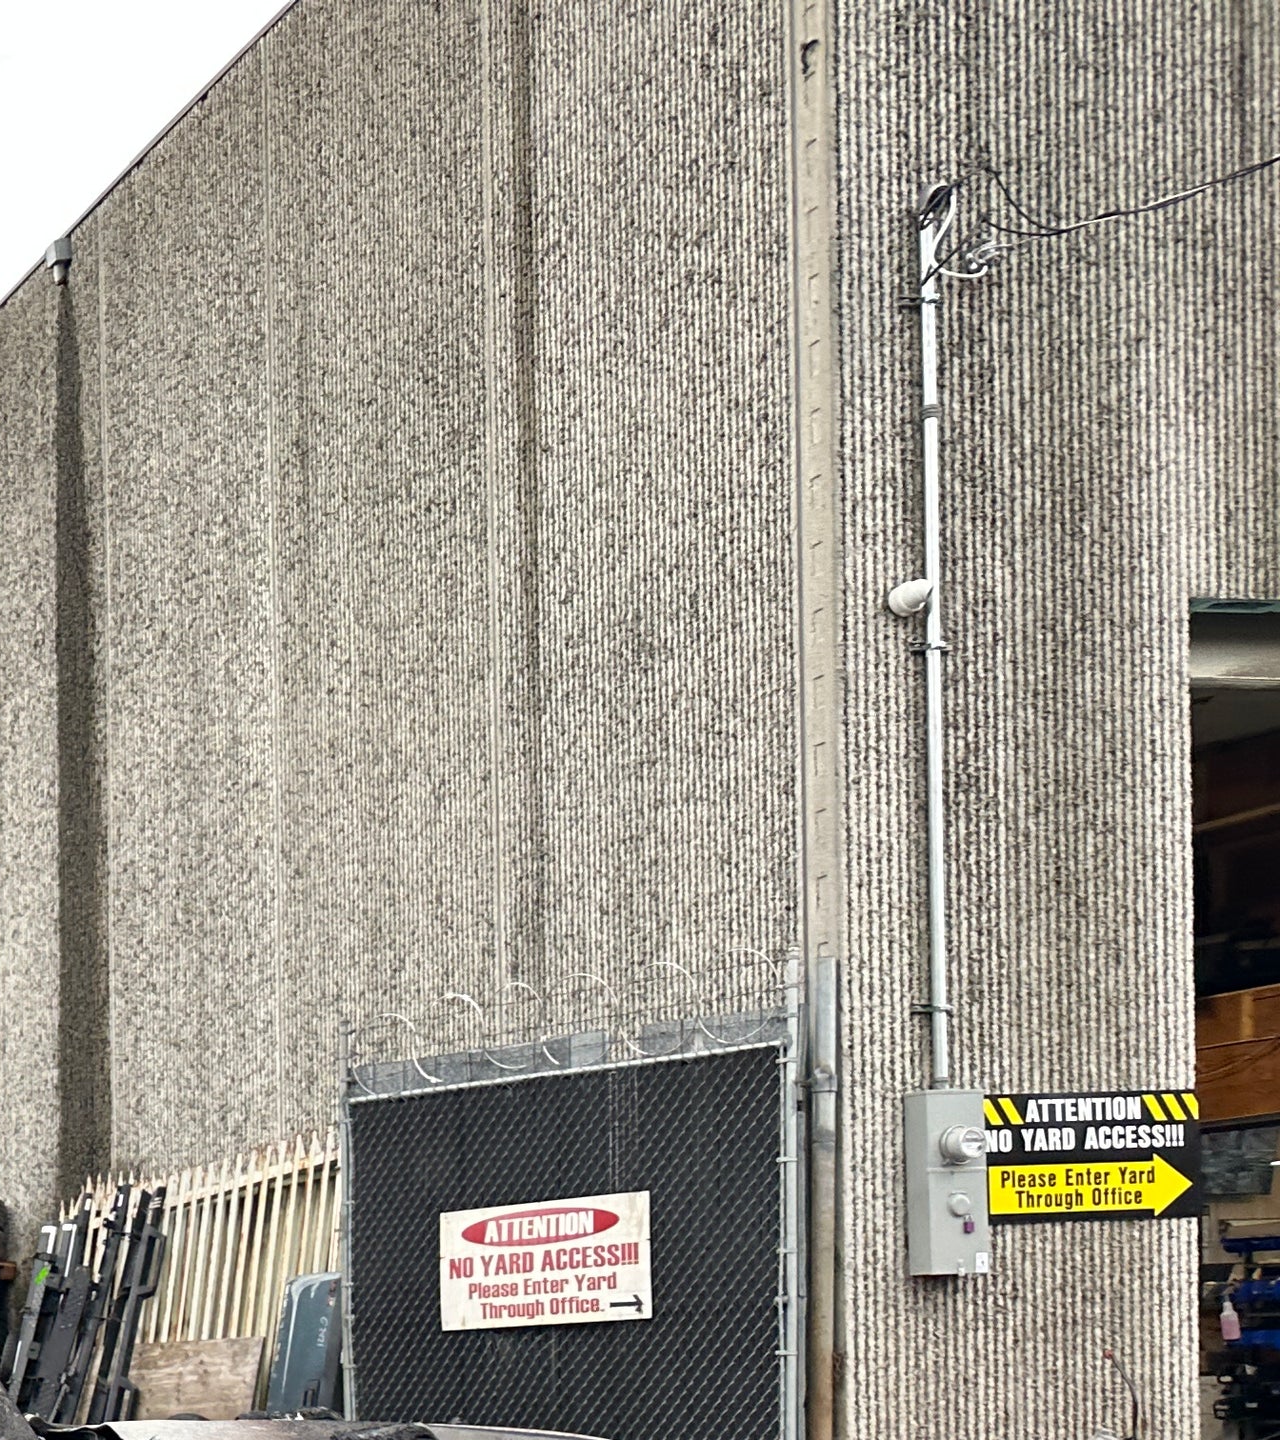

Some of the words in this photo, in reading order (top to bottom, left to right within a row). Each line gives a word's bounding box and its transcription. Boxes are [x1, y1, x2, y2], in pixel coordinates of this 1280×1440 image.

[1025, 1096, 1142, 1123] ATTENTION
[984, 1128, 1013, 1153] NO
[1021, 1127, 1075, 1152] YARD
[1084, 1124, 1185, 1150] ACCESS!!!
[1001, 1170, 1056, 1189] Please
[1065, 1168, 1110, 1186] Enter
[1118, 1166, 1156, 1184] Yard
[1015, 1189, 1084, 1210] Through
[1091, 1188, 1143, 1205] Office
[483, 1209, 595, 1243] ATTENTION
[449, 1257, 474, 1279] NO
[480, 1251, 534, 1277] YARD
[541, 1242, 640, 1272] ACCESS!!!
[468, 1282, 518, 1300] Please
[523, 1276, 569, 1295] Enter
[574, 1272, 617, 1292] Yard
[480, 1299, 544, 1320] Through
[549, 1297, 605, 1315] Office.
